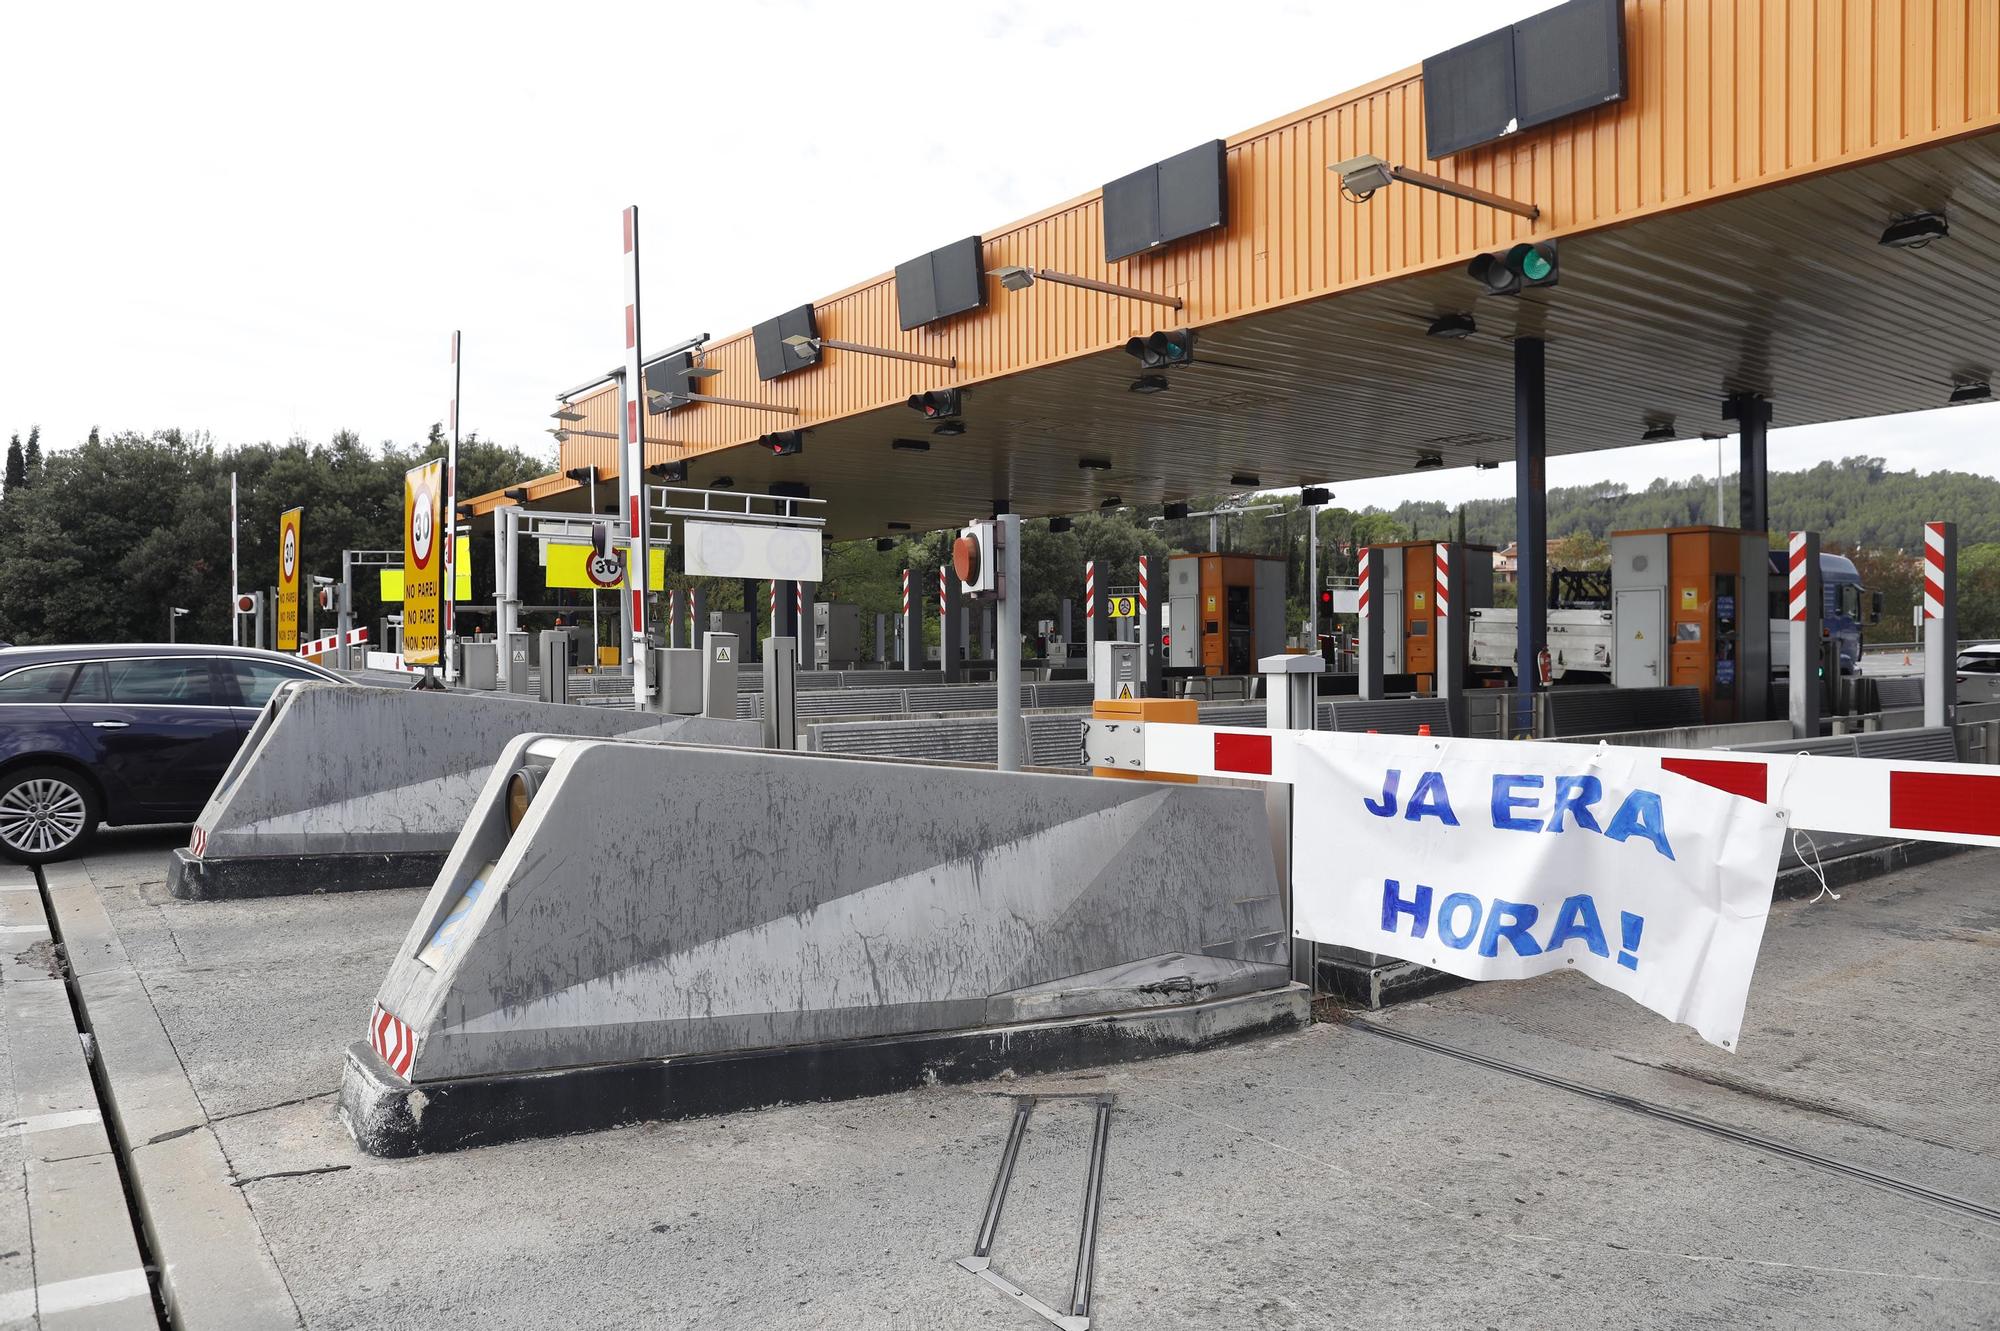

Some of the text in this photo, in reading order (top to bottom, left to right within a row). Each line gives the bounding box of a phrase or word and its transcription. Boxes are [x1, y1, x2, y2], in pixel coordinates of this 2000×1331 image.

[415, 511, 430, 542] 30
[285, 542, 293, 563] 30
[595, 560, 618, 574] 30
[406, 581, 437, 599] NO PAREU
[408, 608, 435, 625] NO PARE
[405, 635, 438, 651] NON STOP
[1363, 769, 1676, 861] JA ERA
[1381, 879, 1644, 971] HORA!
